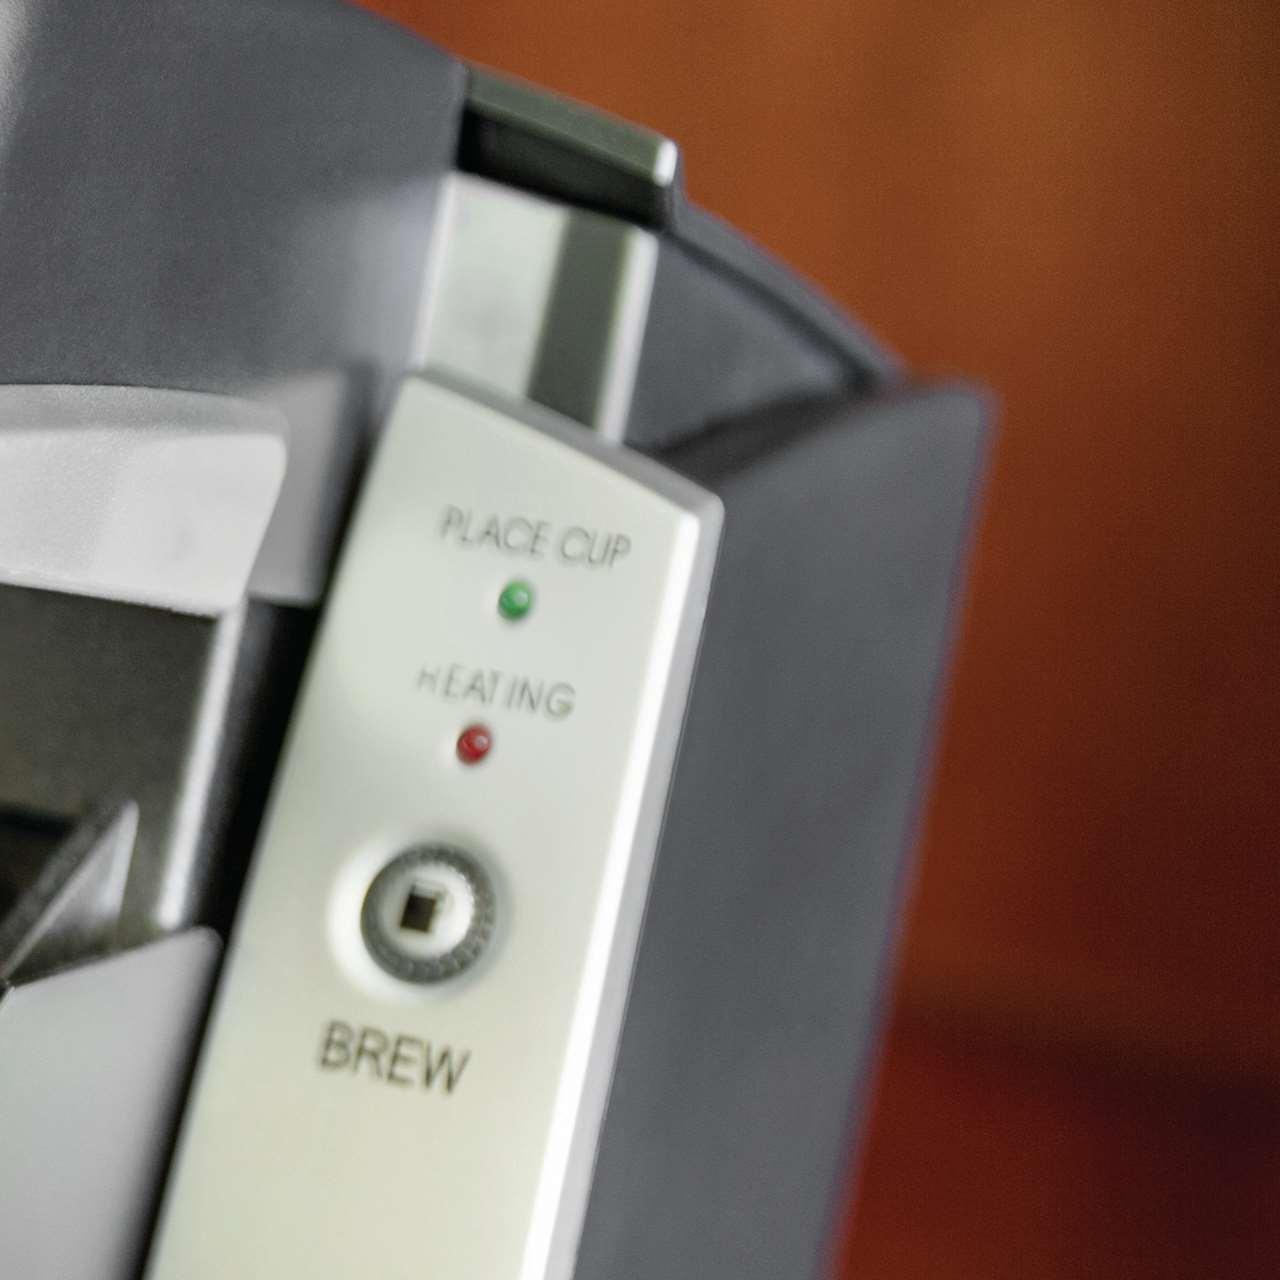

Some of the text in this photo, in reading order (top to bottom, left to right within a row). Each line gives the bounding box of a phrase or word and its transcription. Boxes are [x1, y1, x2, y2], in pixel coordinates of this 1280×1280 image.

[441, 504, 632, 568] PLACE CUP
[417, 663, 576, 720] HEATING
[320, 1019, 473, 1094] BREW
